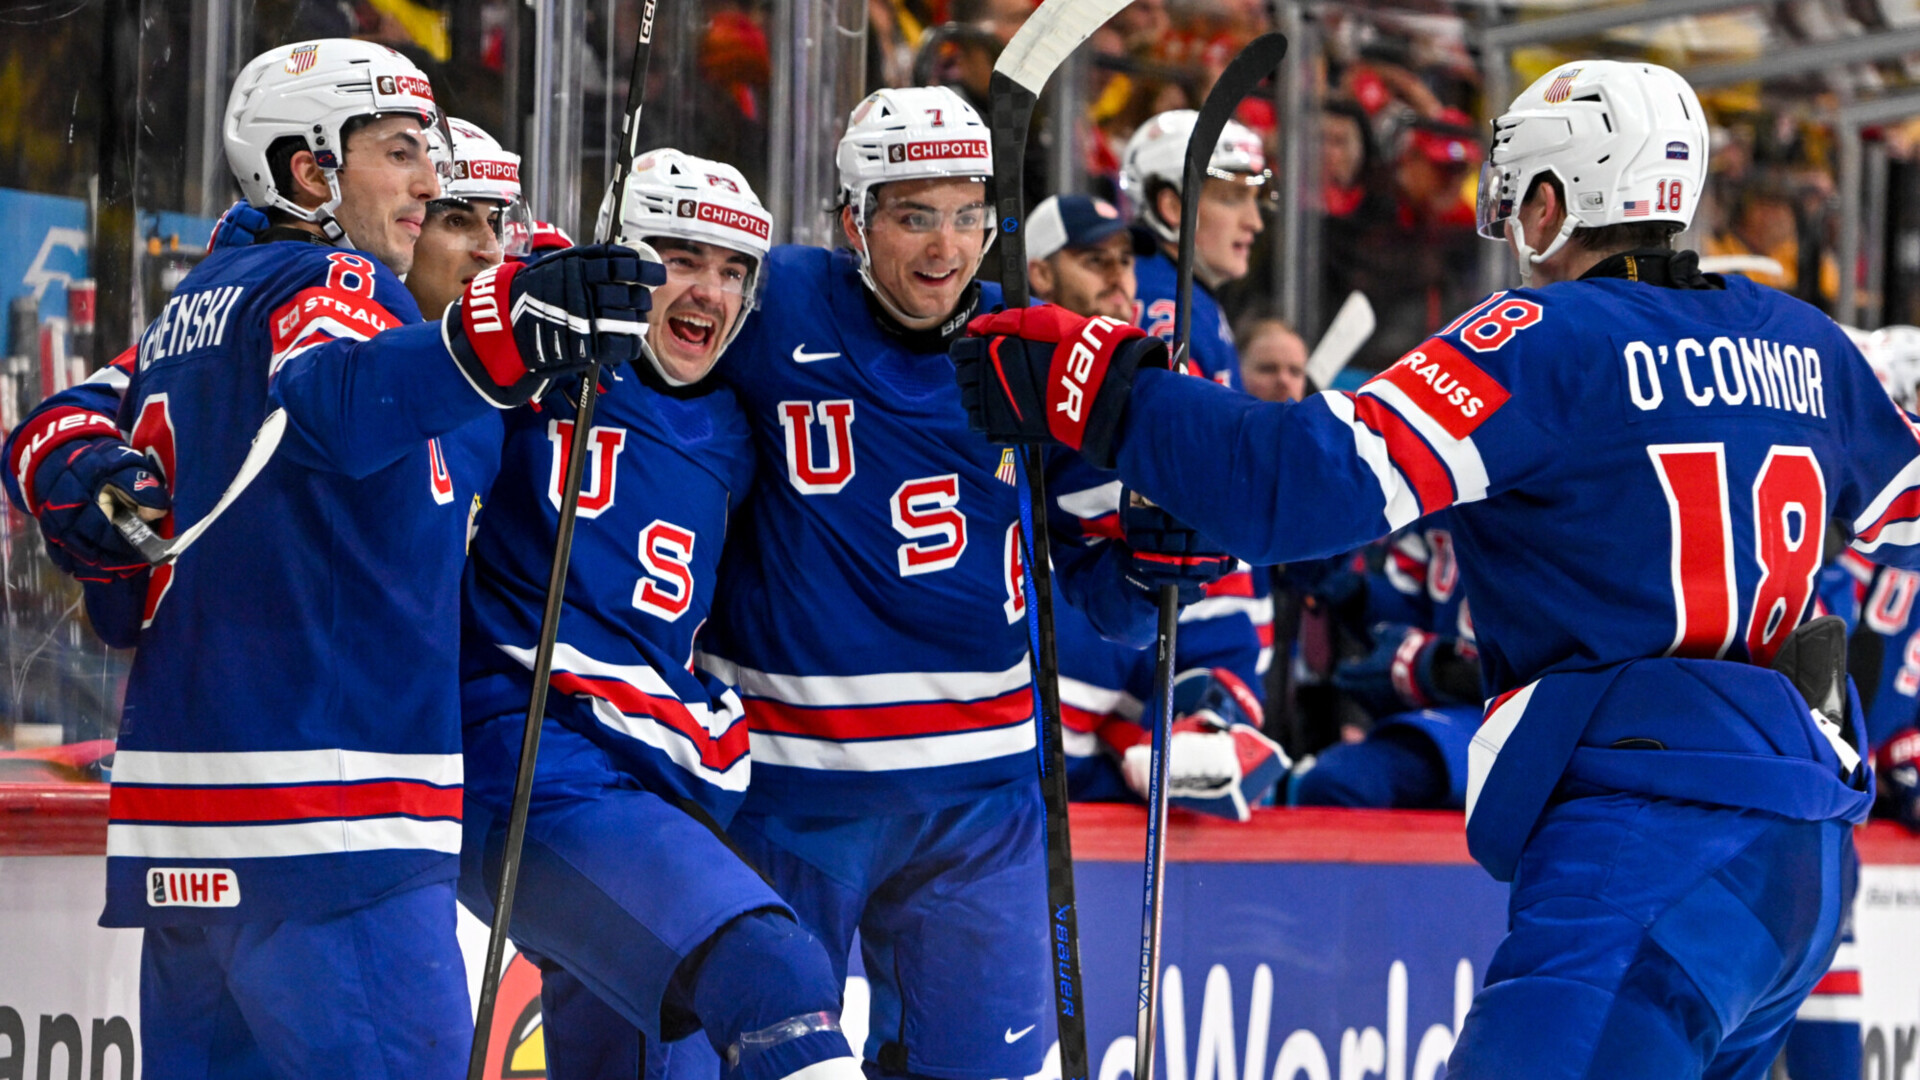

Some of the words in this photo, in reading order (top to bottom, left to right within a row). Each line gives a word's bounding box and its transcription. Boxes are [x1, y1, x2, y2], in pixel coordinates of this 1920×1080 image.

[925, 108, 945, 128] 7
[910, 142, 987, 158] CHIPOTLE
[1656, 179, 1683, 213] 18
[700, 205, 769, 236] CHIPOTLE
[326, 252, 376, 299] 8
[304, 295, 391, 332] STRAU
[1435, 290, 1544, 353] 18
[1402, 351, 1484, 418] RAUSS
[1624, 336, 1827, 419] O'CONNOR
[1646, 442, 1827, 667] 18
[169, 872, 229, 903] IIHF
[1055, 924, 1075, 1017] BAUER
